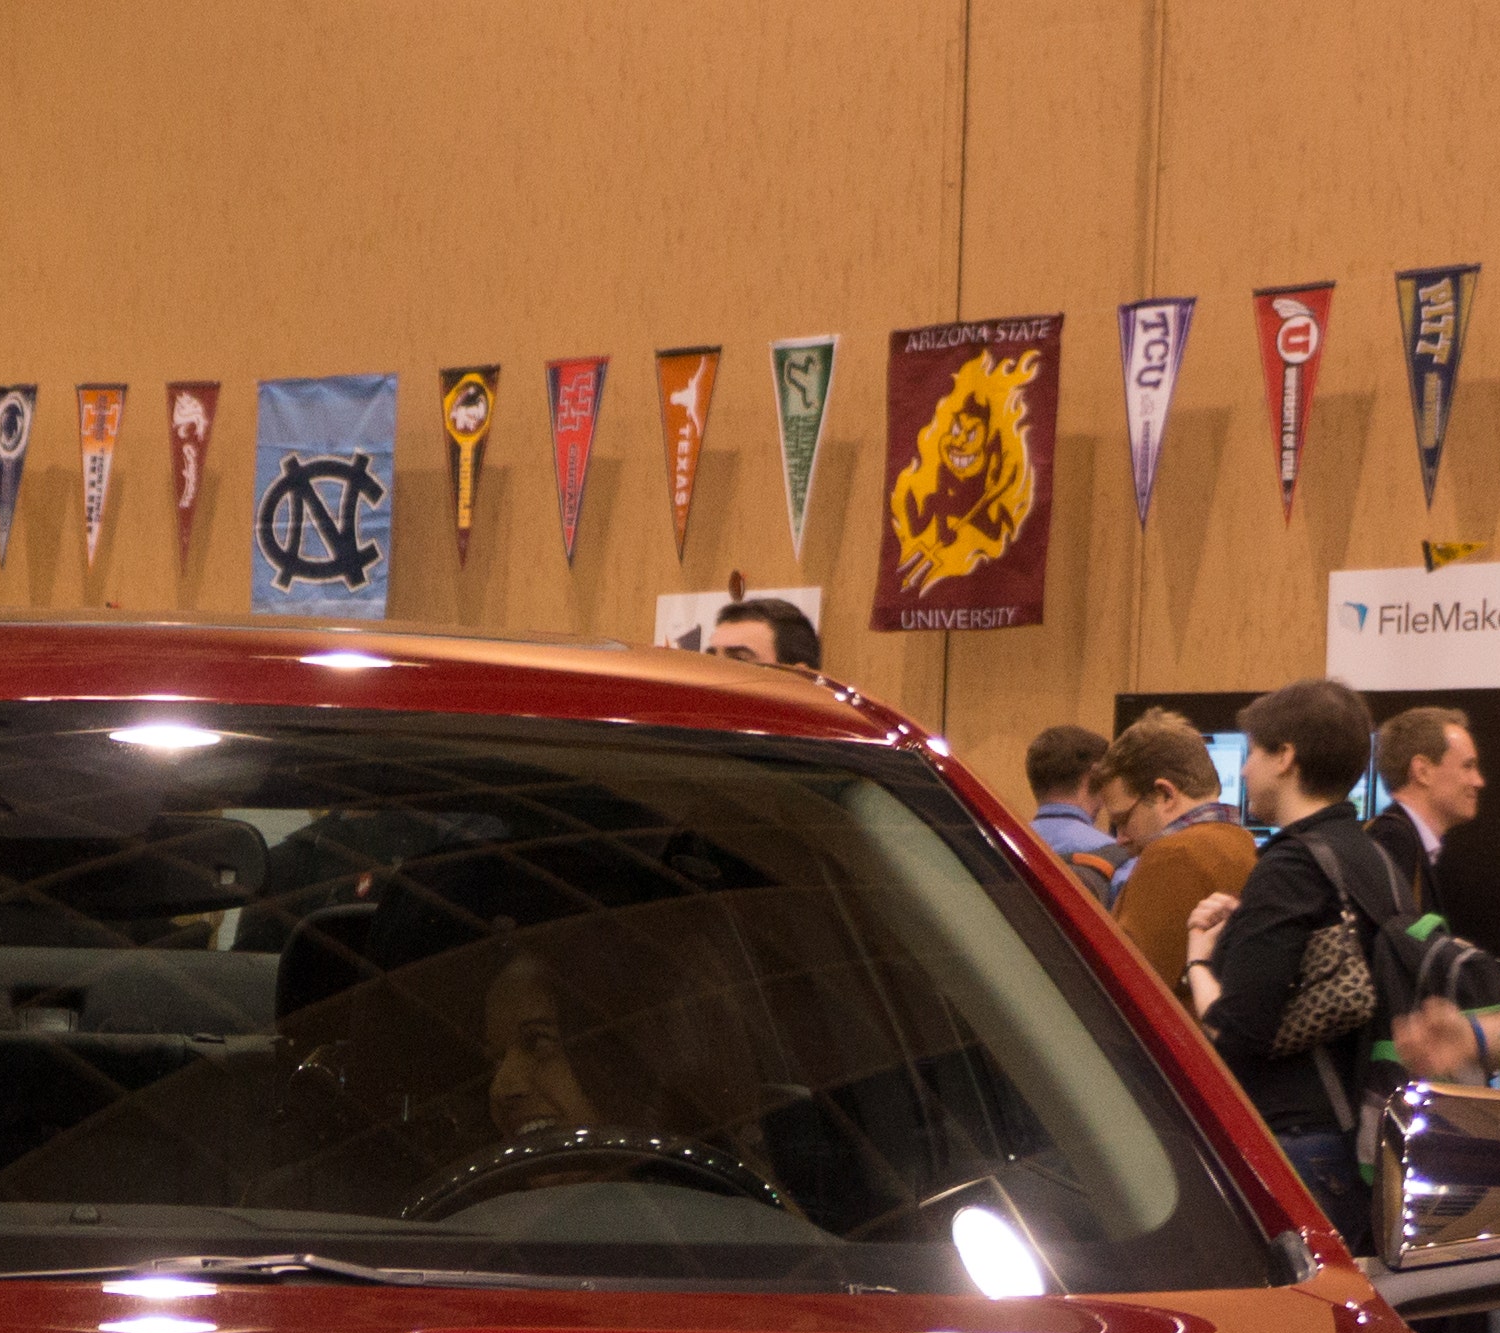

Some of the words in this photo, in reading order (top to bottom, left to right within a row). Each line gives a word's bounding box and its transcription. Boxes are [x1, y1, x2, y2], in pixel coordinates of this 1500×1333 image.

[904, 323, 989, 353] ARIZONA
[995, 317, 1052, 345] STATE
[1135, 311, 1172, 391] TCU
[1415, 277, 1454, 365] PITT
[1282, 366, 1298, 432] UNIVERSITY
[675, 423, 692, 506] TEXAS
[1280, 449, 1296, 481] UTAH
[1281, 434, 1296, 447] OF
[566, 443, 580, 527] COUGARS
[900, 607, 1017, 631] UNIVERSITY
